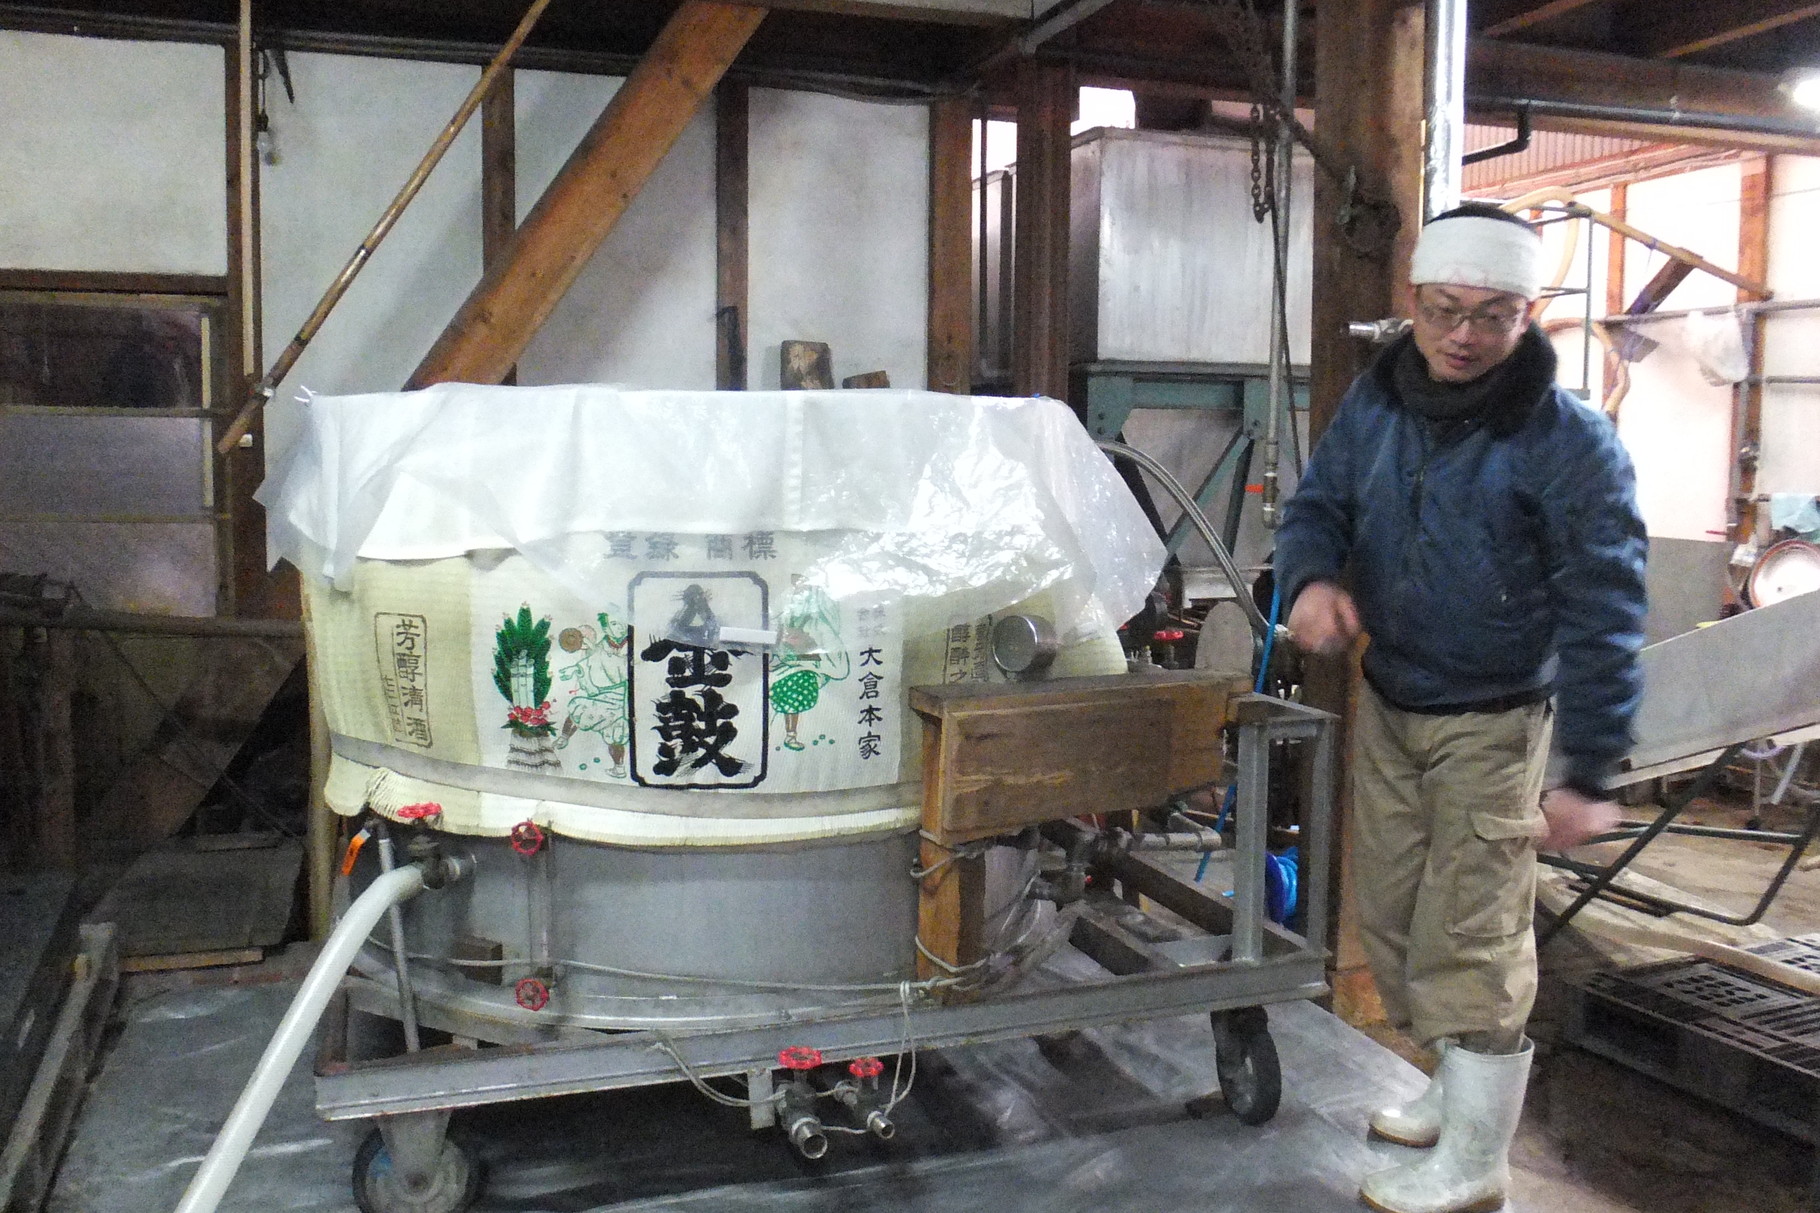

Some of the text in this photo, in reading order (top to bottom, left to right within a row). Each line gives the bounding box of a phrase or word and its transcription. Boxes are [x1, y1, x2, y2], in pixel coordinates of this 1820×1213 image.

[640, 583, 756, 778] 金鼓
[857, 646, 883, 760] 大倉本家
